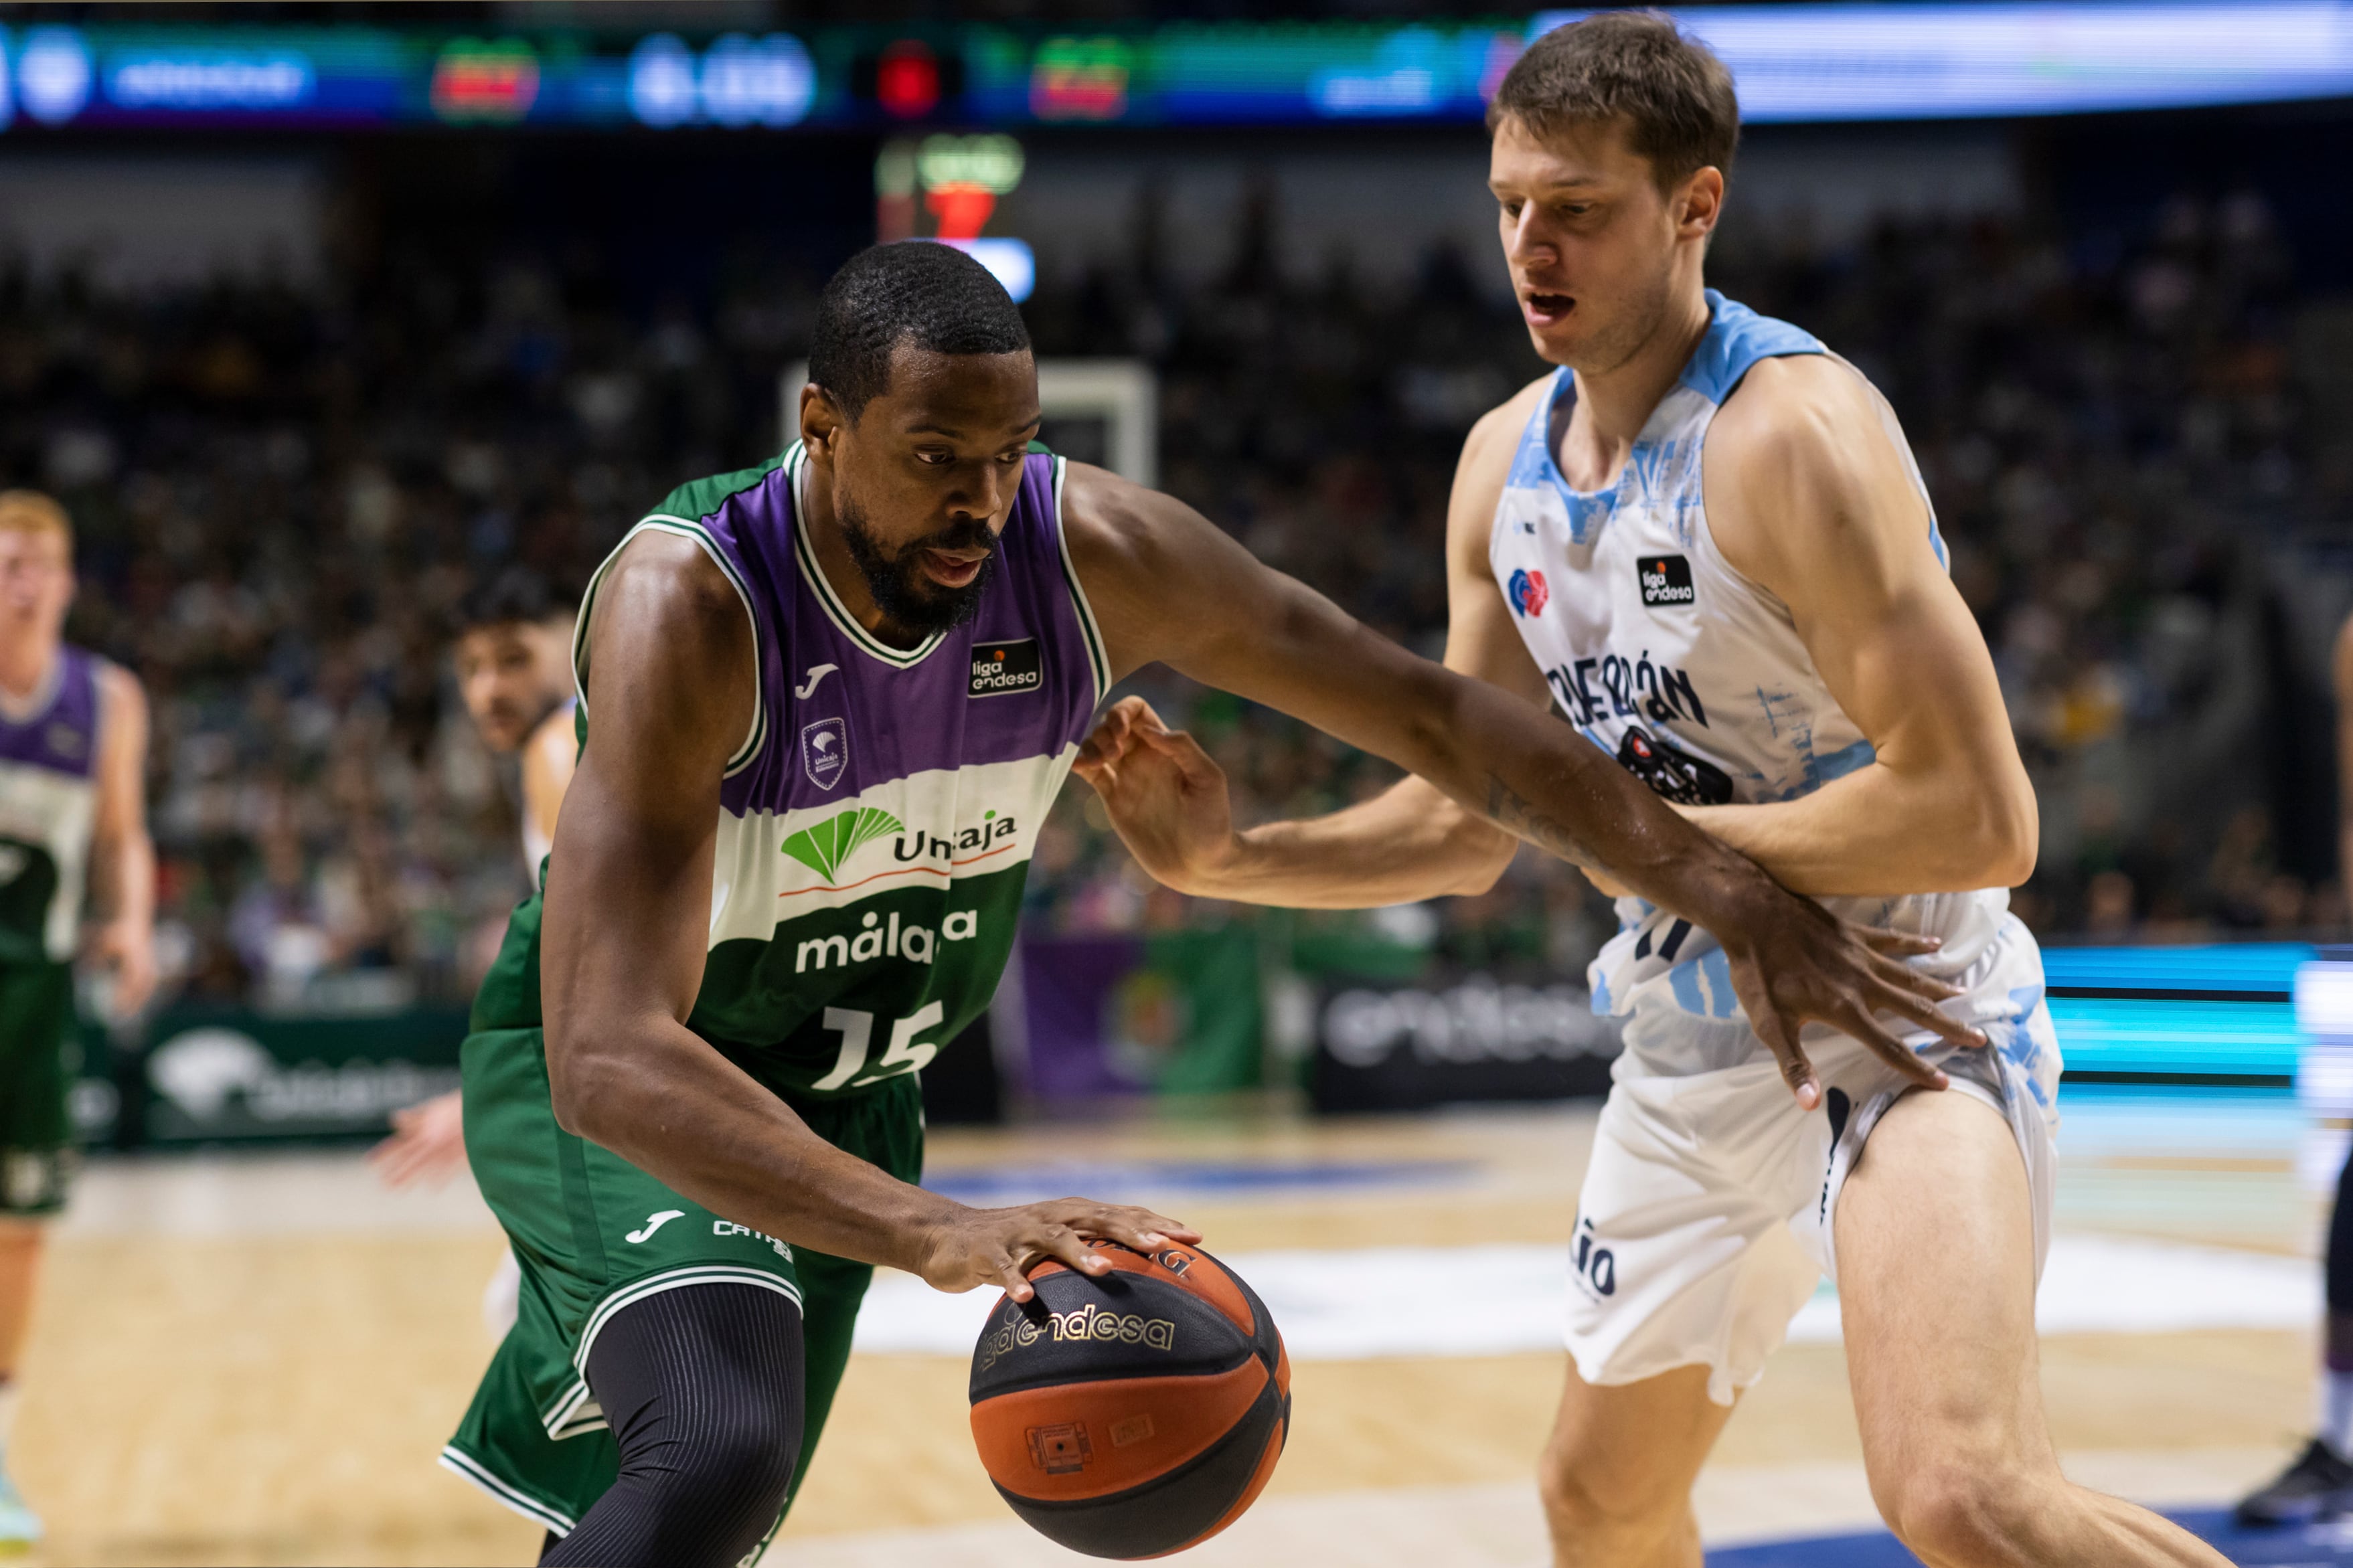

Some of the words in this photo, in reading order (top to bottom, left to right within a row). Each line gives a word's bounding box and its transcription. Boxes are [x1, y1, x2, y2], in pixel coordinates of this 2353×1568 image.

[1642, 570, 1666, 589] liga
[1645, 584, 1692, 602] endesa
[972, 661, 1003, 677] liga
[972, 672, 1037, 690] endesa
[894, 810, 1017, 862] Unaja
[795, 911, 978, 974] málaa
[810, 999, 944, 1091] 15
[1016, 1304, 1175, 1351] endesa
